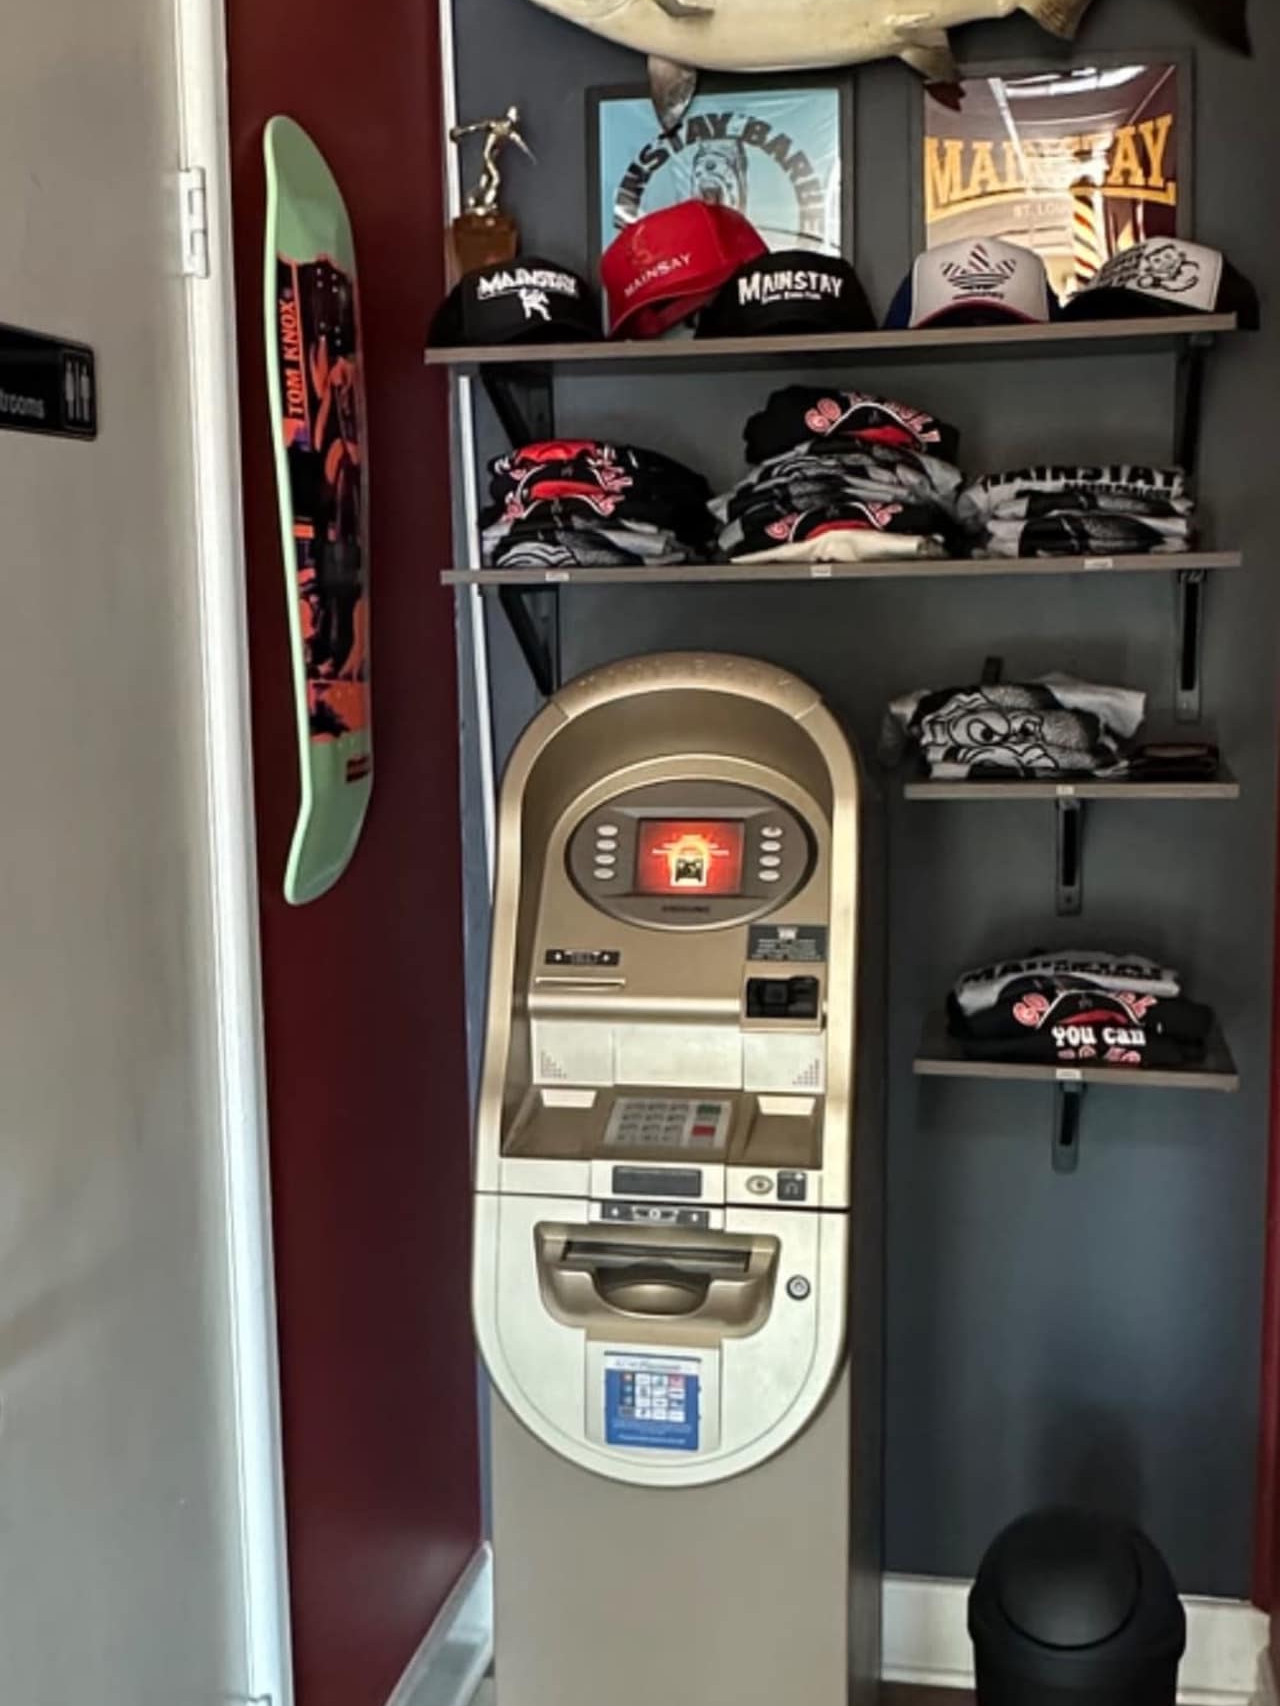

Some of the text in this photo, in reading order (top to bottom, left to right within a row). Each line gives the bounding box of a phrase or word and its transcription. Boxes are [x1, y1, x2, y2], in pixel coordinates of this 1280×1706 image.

[613, 113, 734, 231] INSTAY
[924, 114, 1176, 205] MAIAY
[738, 269, 843, 305] MAINSTAY
[278, 298, 304, 417] TOM KNOX
